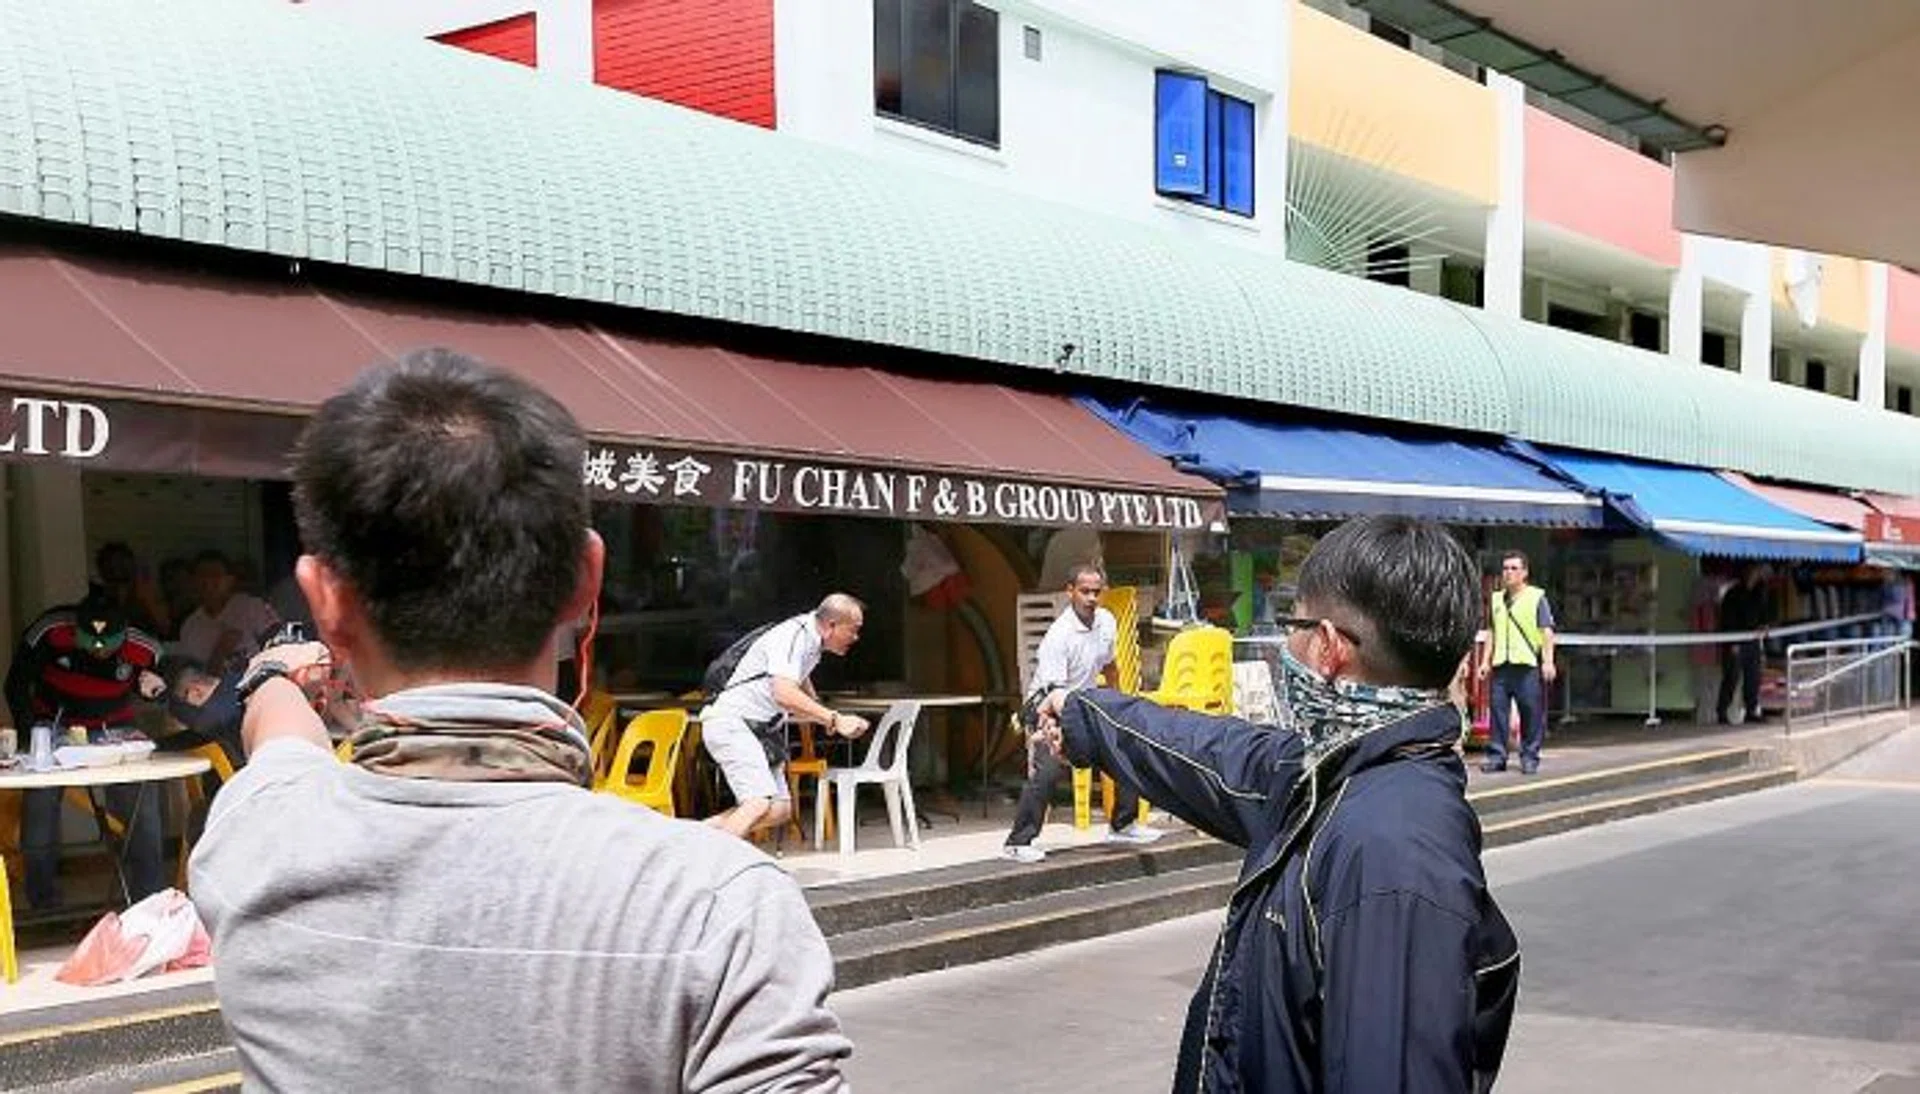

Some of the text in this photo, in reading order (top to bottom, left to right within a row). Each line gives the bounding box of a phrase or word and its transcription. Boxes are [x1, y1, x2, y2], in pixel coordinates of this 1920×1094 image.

[731, 459, 1203, 529] FU CHAN F & B GROUP PTE LTD
